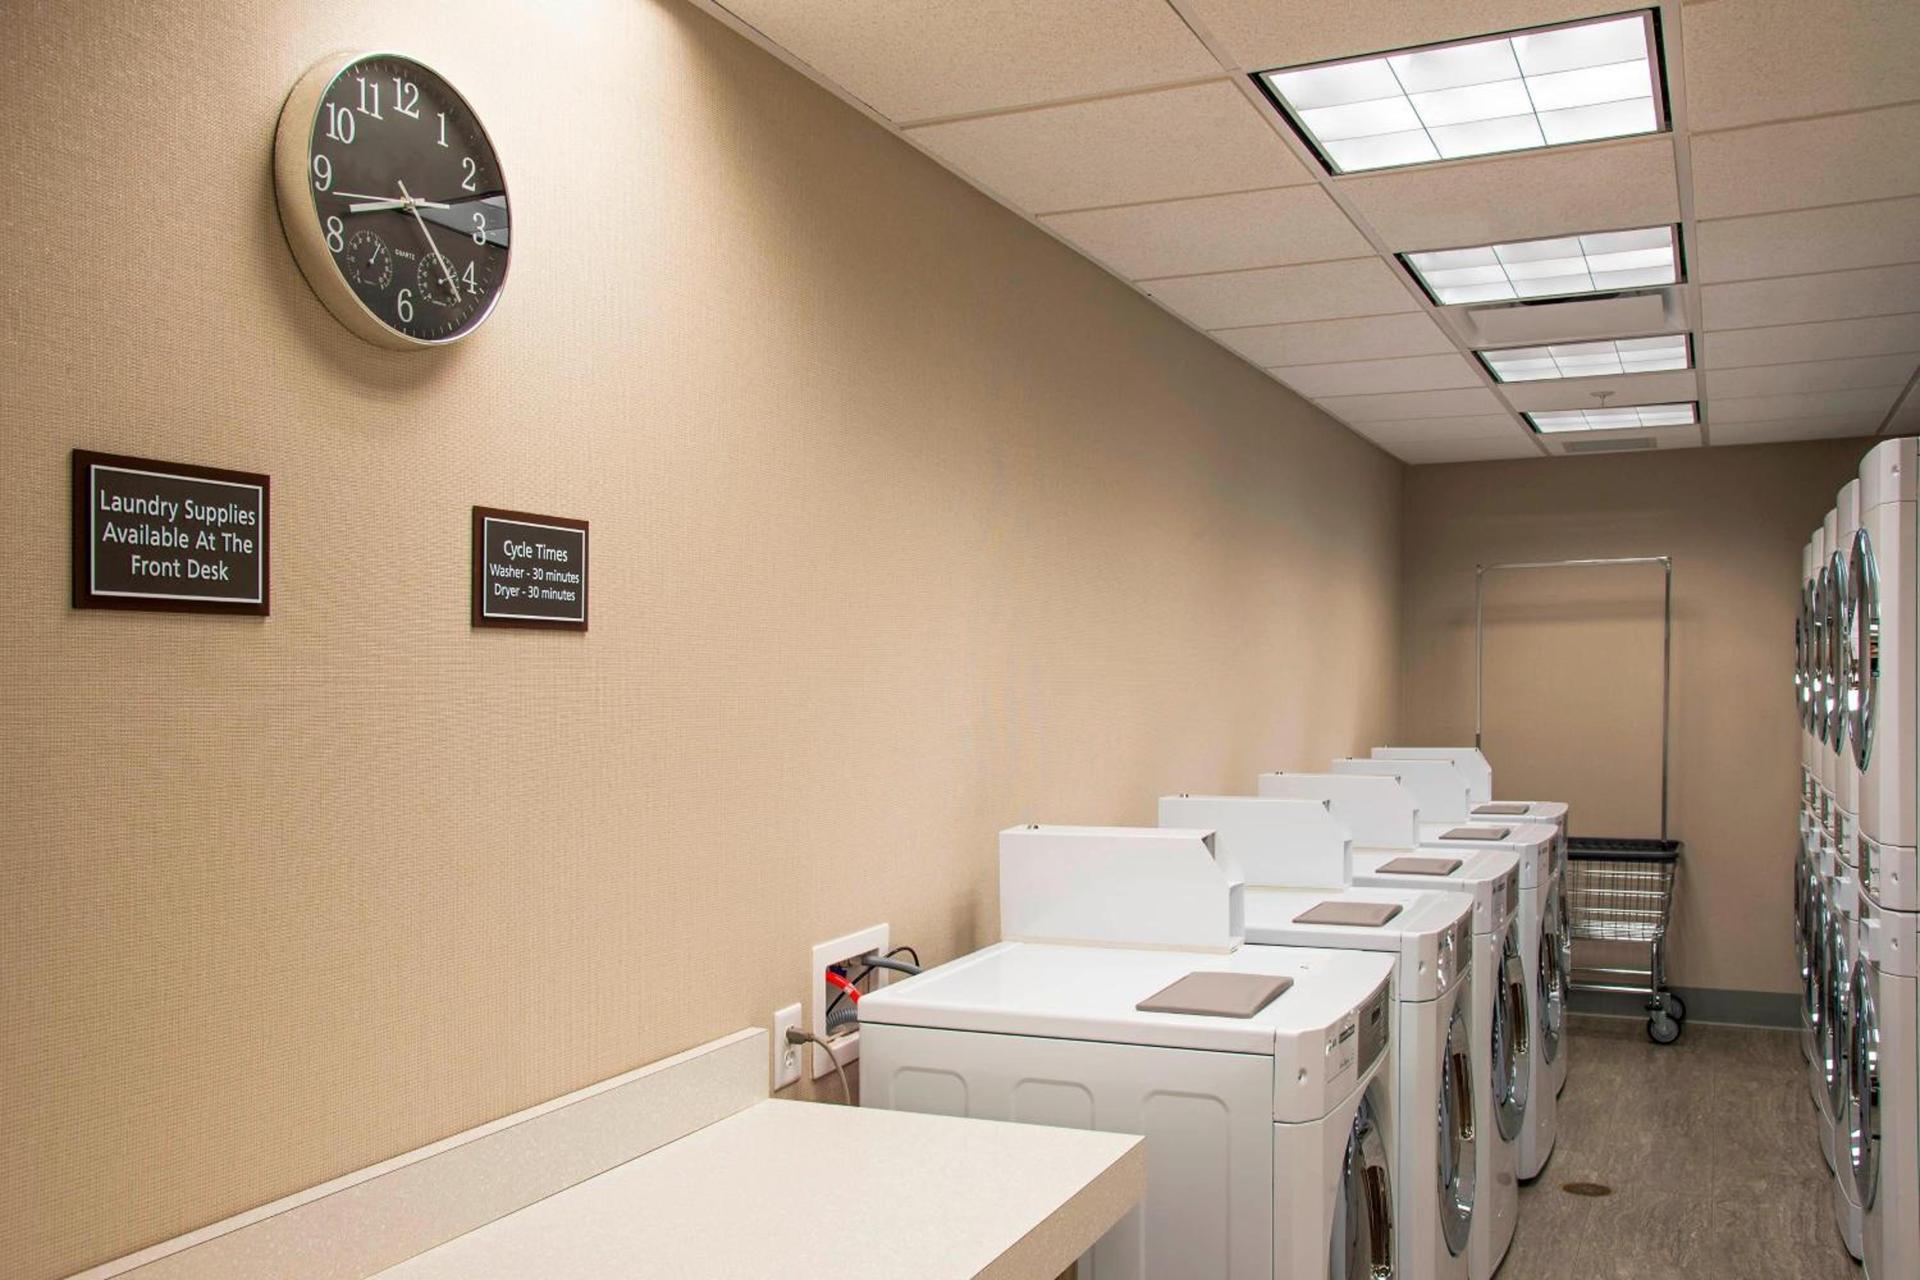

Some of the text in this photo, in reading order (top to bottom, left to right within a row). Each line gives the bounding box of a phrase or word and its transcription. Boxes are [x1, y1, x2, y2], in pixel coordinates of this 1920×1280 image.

[356, 77, 384, 121] 11
[392, 77, 420, 119] 12
[325, 102, 356, 144] 10
[436, 112, 449, 148] 1
[313, 154, 333, 192] 9
[461, 157, 477, 192] 2
[326, 216, 344, 253] 8
[472, 212, 487, 245] 3
[462, 260, 477, 294] 4
[397, 289, 414, 323] 6
[100, 490, 256, 526] Laundry Supplies
[102, 522, 253, 554] Available At The
[503, 540, 567, 562] Cycle Times
[131, 554, 230, 581] Front Desk
[489, 563, 524, 579] Washer
[532, 567, 544, 581] 30
[545, 570, 580, 584] minutes
[494, 583, 520, 599] Dryer
[527, 585, 540, 599] 30
[541, 588, 576, 601] minutes
